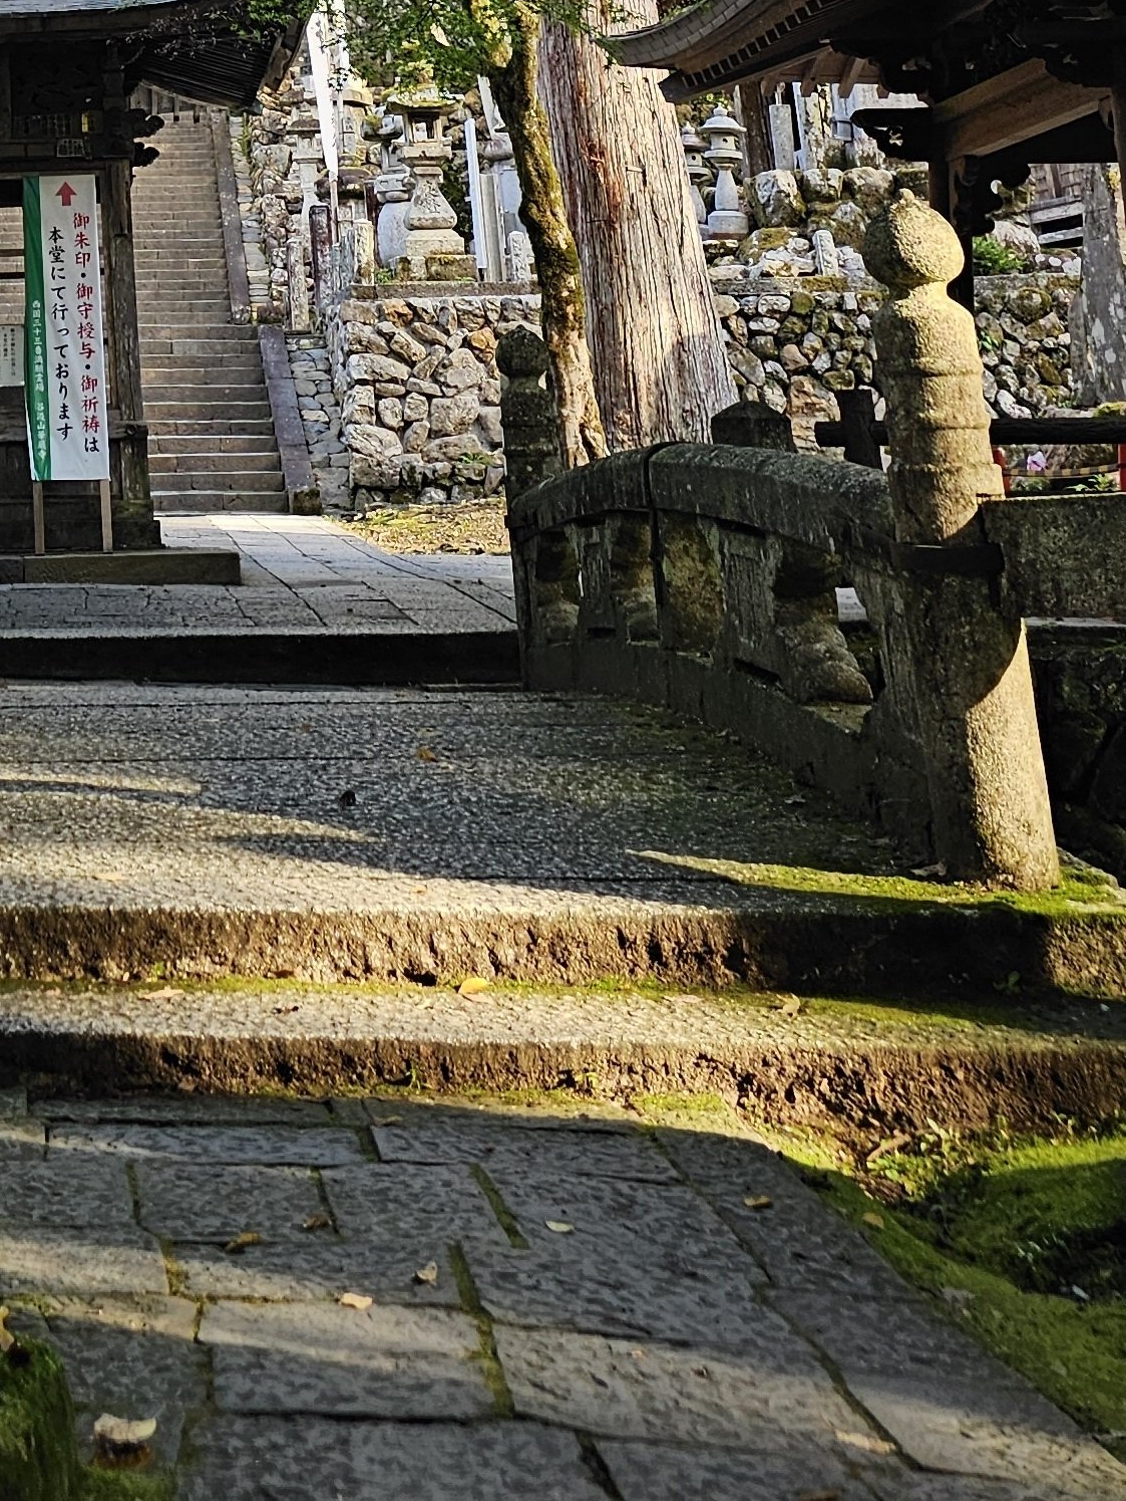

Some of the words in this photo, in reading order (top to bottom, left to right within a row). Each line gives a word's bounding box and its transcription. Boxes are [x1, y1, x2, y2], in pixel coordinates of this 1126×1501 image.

[48, 226, 73, 441] 本堂にて行っております
[73, 212, 101, 453] 御朱印・御守授与・御祈祷は
